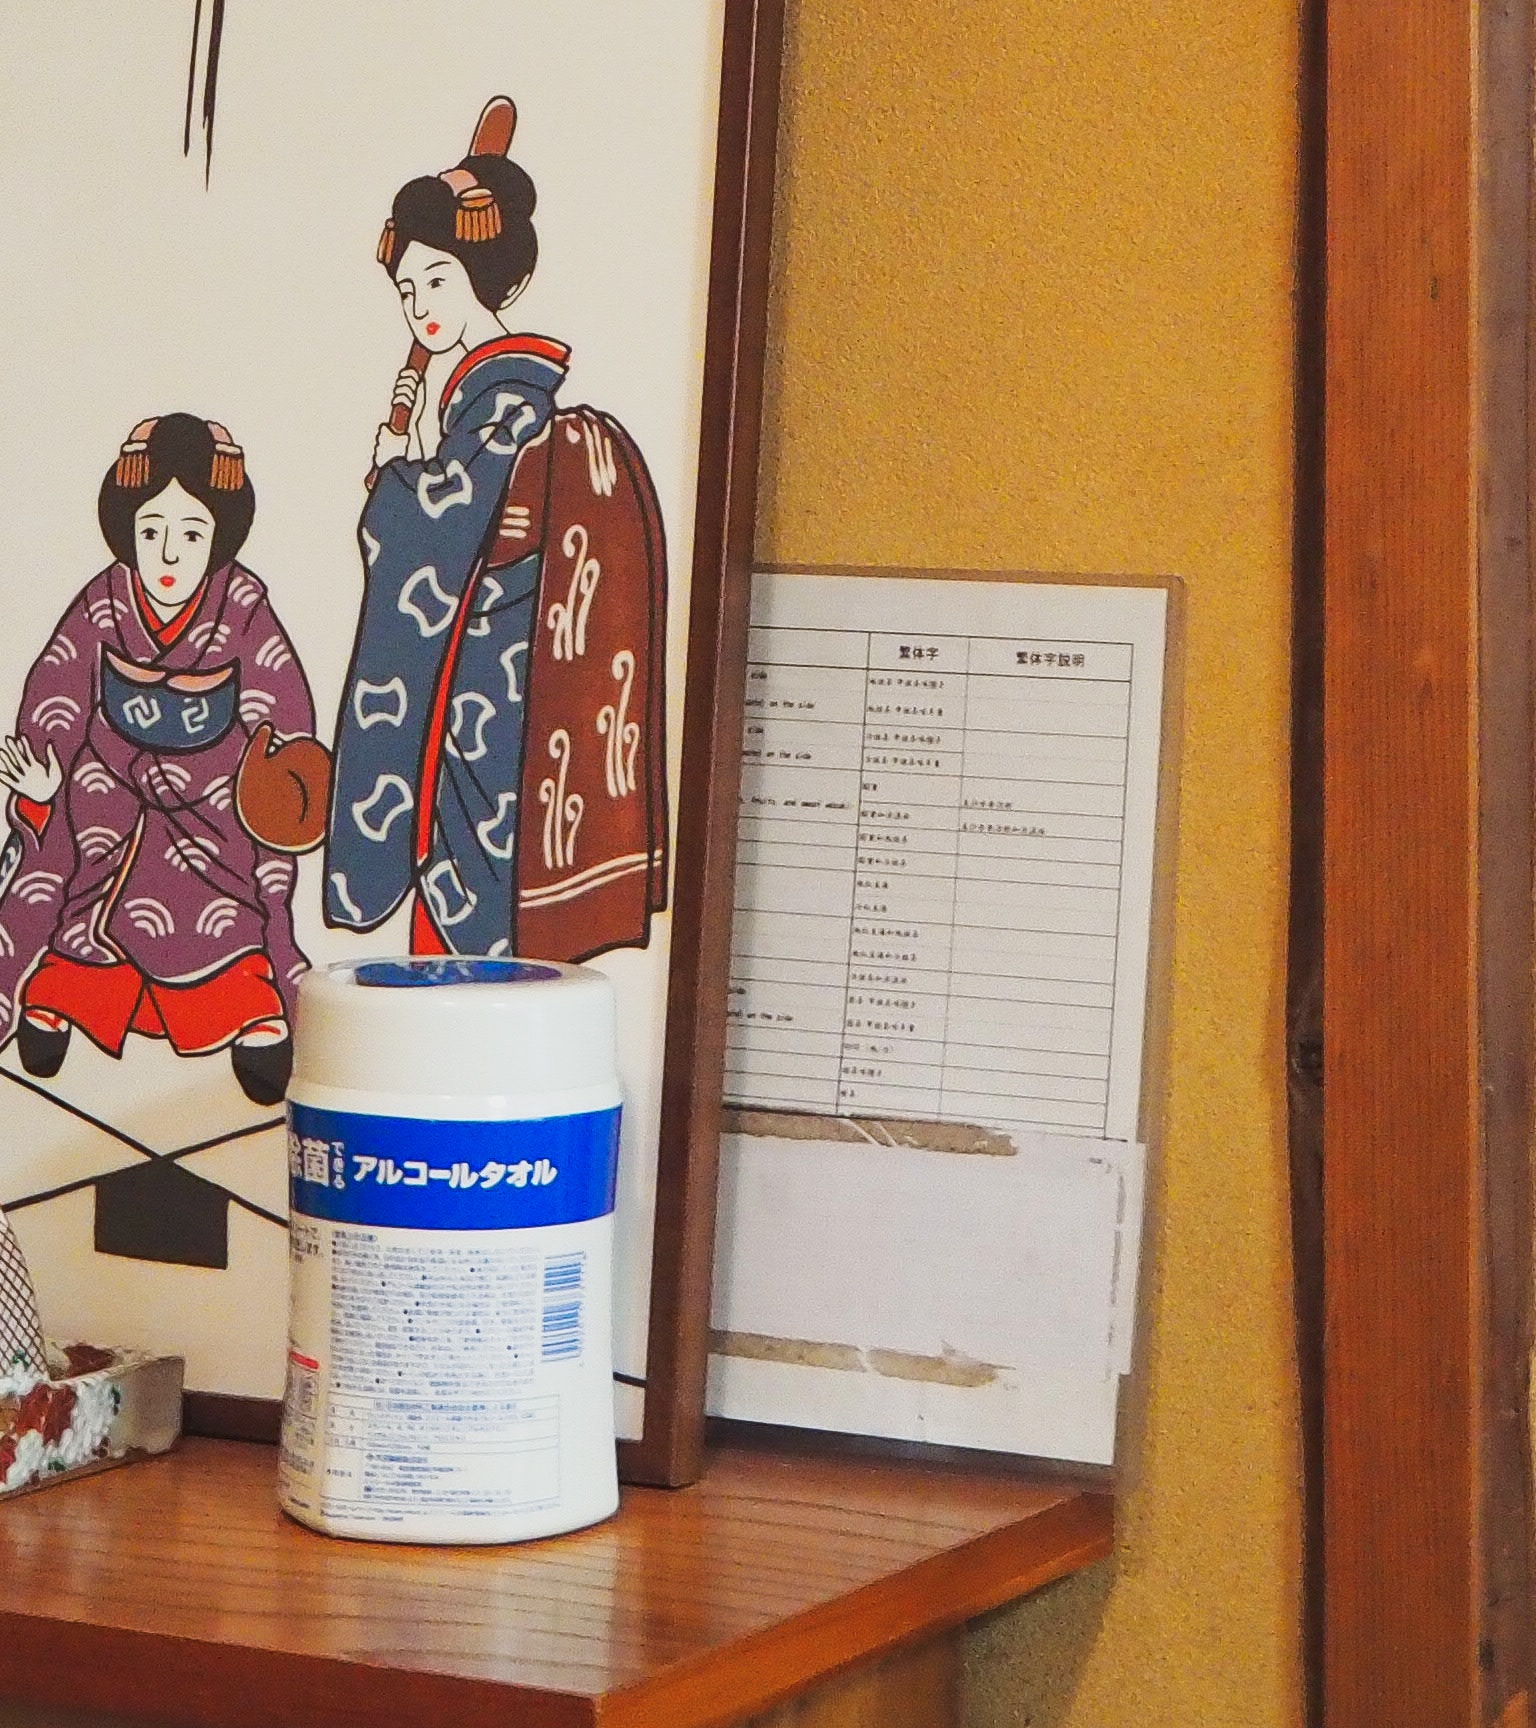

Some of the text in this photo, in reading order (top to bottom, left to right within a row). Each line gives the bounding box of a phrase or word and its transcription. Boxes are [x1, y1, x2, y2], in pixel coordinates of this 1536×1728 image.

[352, 1155, 558, 1189] アルコールタオル
